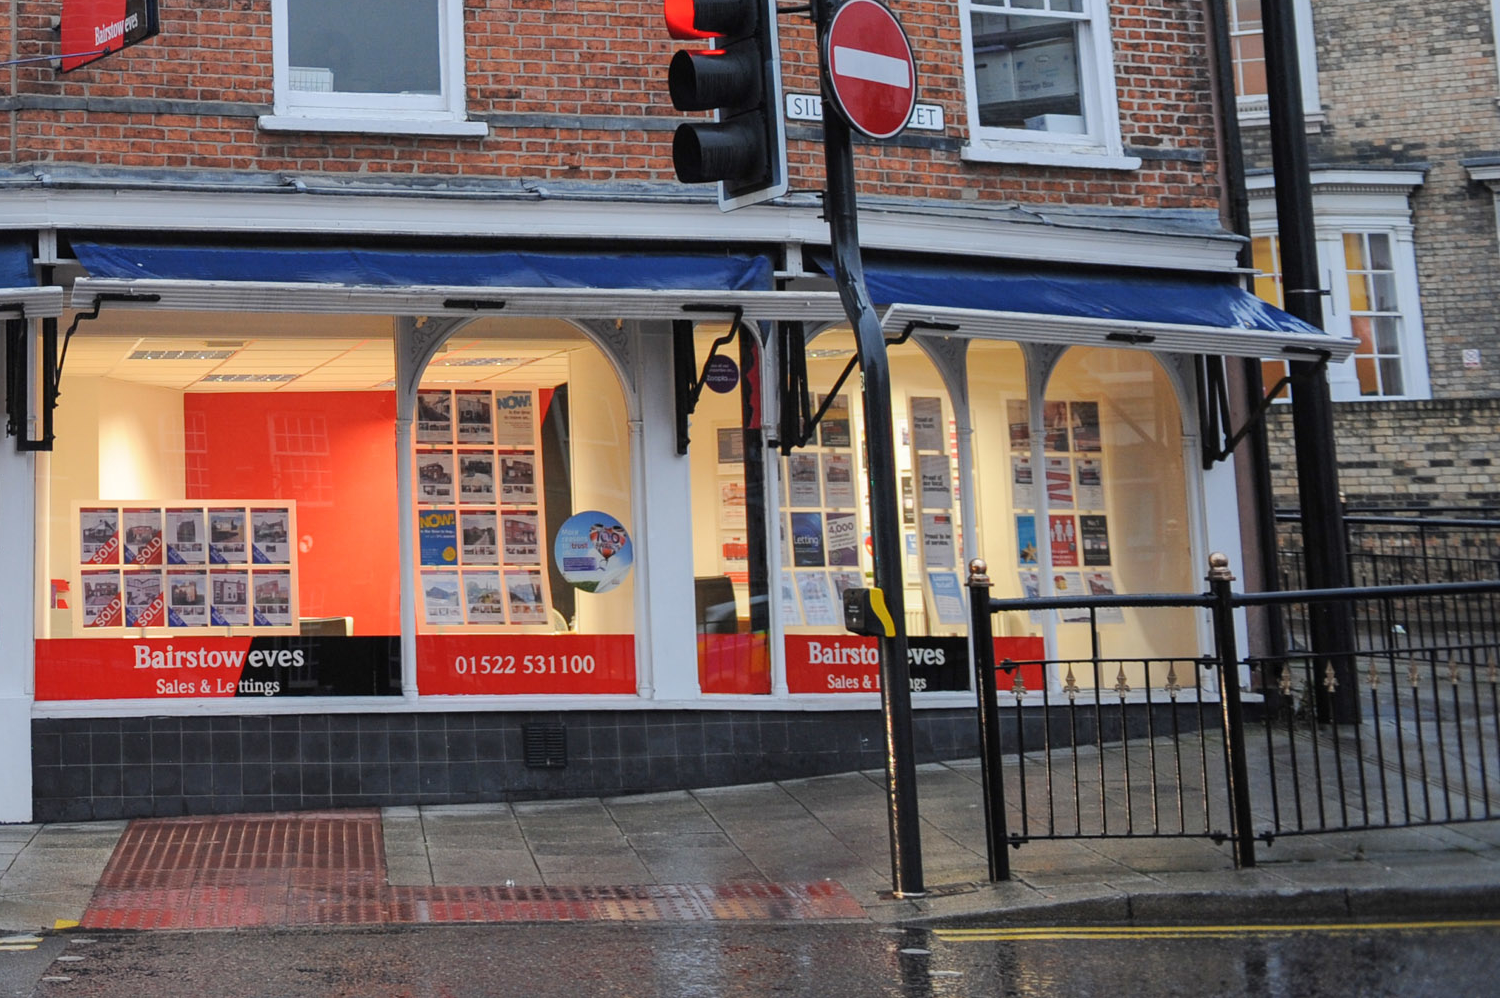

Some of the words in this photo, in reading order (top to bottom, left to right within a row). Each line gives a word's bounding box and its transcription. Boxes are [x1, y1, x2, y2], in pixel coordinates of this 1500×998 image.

[95, 20, 124, 46] Bairstow
[125, 13, 138, 32] eves
[794, 97, 822, 116] SIL
[496, 395, 532, 410] NOW!
[419, 513, 455, 529] NOW!
[828, 522, 854, 534] 4,000
[92, 536, 119, 564] SOLD
[136, 536, 162, 564] SOLD
[571, 542, 589, 550] trust
[95, 598, 122, 627] SOLD
[137, 598, 164, 627] SOLD
[133, 645, 246, 669] Bairstow
[248, 649, 305, 667] eves
[807, 641, 879, 665] Bairsto
[455, 655, 516, 674] 01522
[522, 655, 595, 674] 531100
[156, 678, 195, 694] Sales
[200, 679, 211, 694] &
[827, 674, 859, 689] Sales
[862, 674, 872, 689] &
